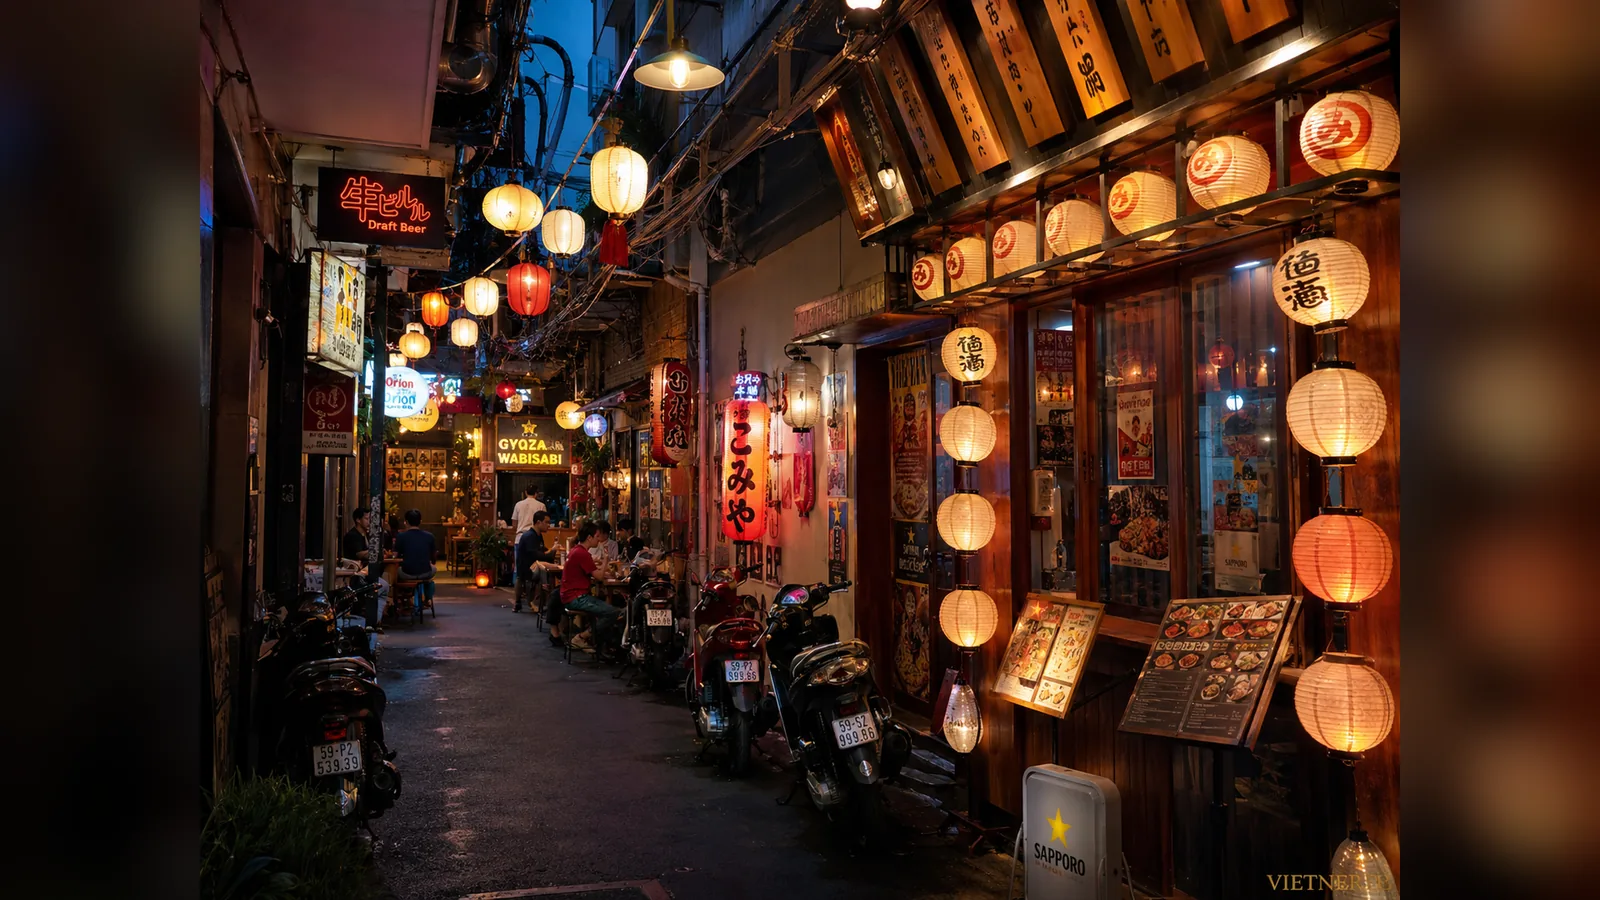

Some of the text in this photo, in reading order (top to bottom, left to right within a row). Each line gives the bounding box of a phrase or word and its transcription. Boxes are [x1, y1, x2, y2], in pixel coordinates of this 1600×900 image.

[368, 219, 427, 234] Draft Beer
[385, 377, 414, 389] Orion
[497, 452, 562, 465] WABISABI
[726, 422, 756, 533] こみや
[838, 726, 875, 747] 999.86
[321, 743, 353, 760] 59-P2
[317, 756, 359, 775] 539.39
[1033, 842, 1086, 877] SAPPORO
